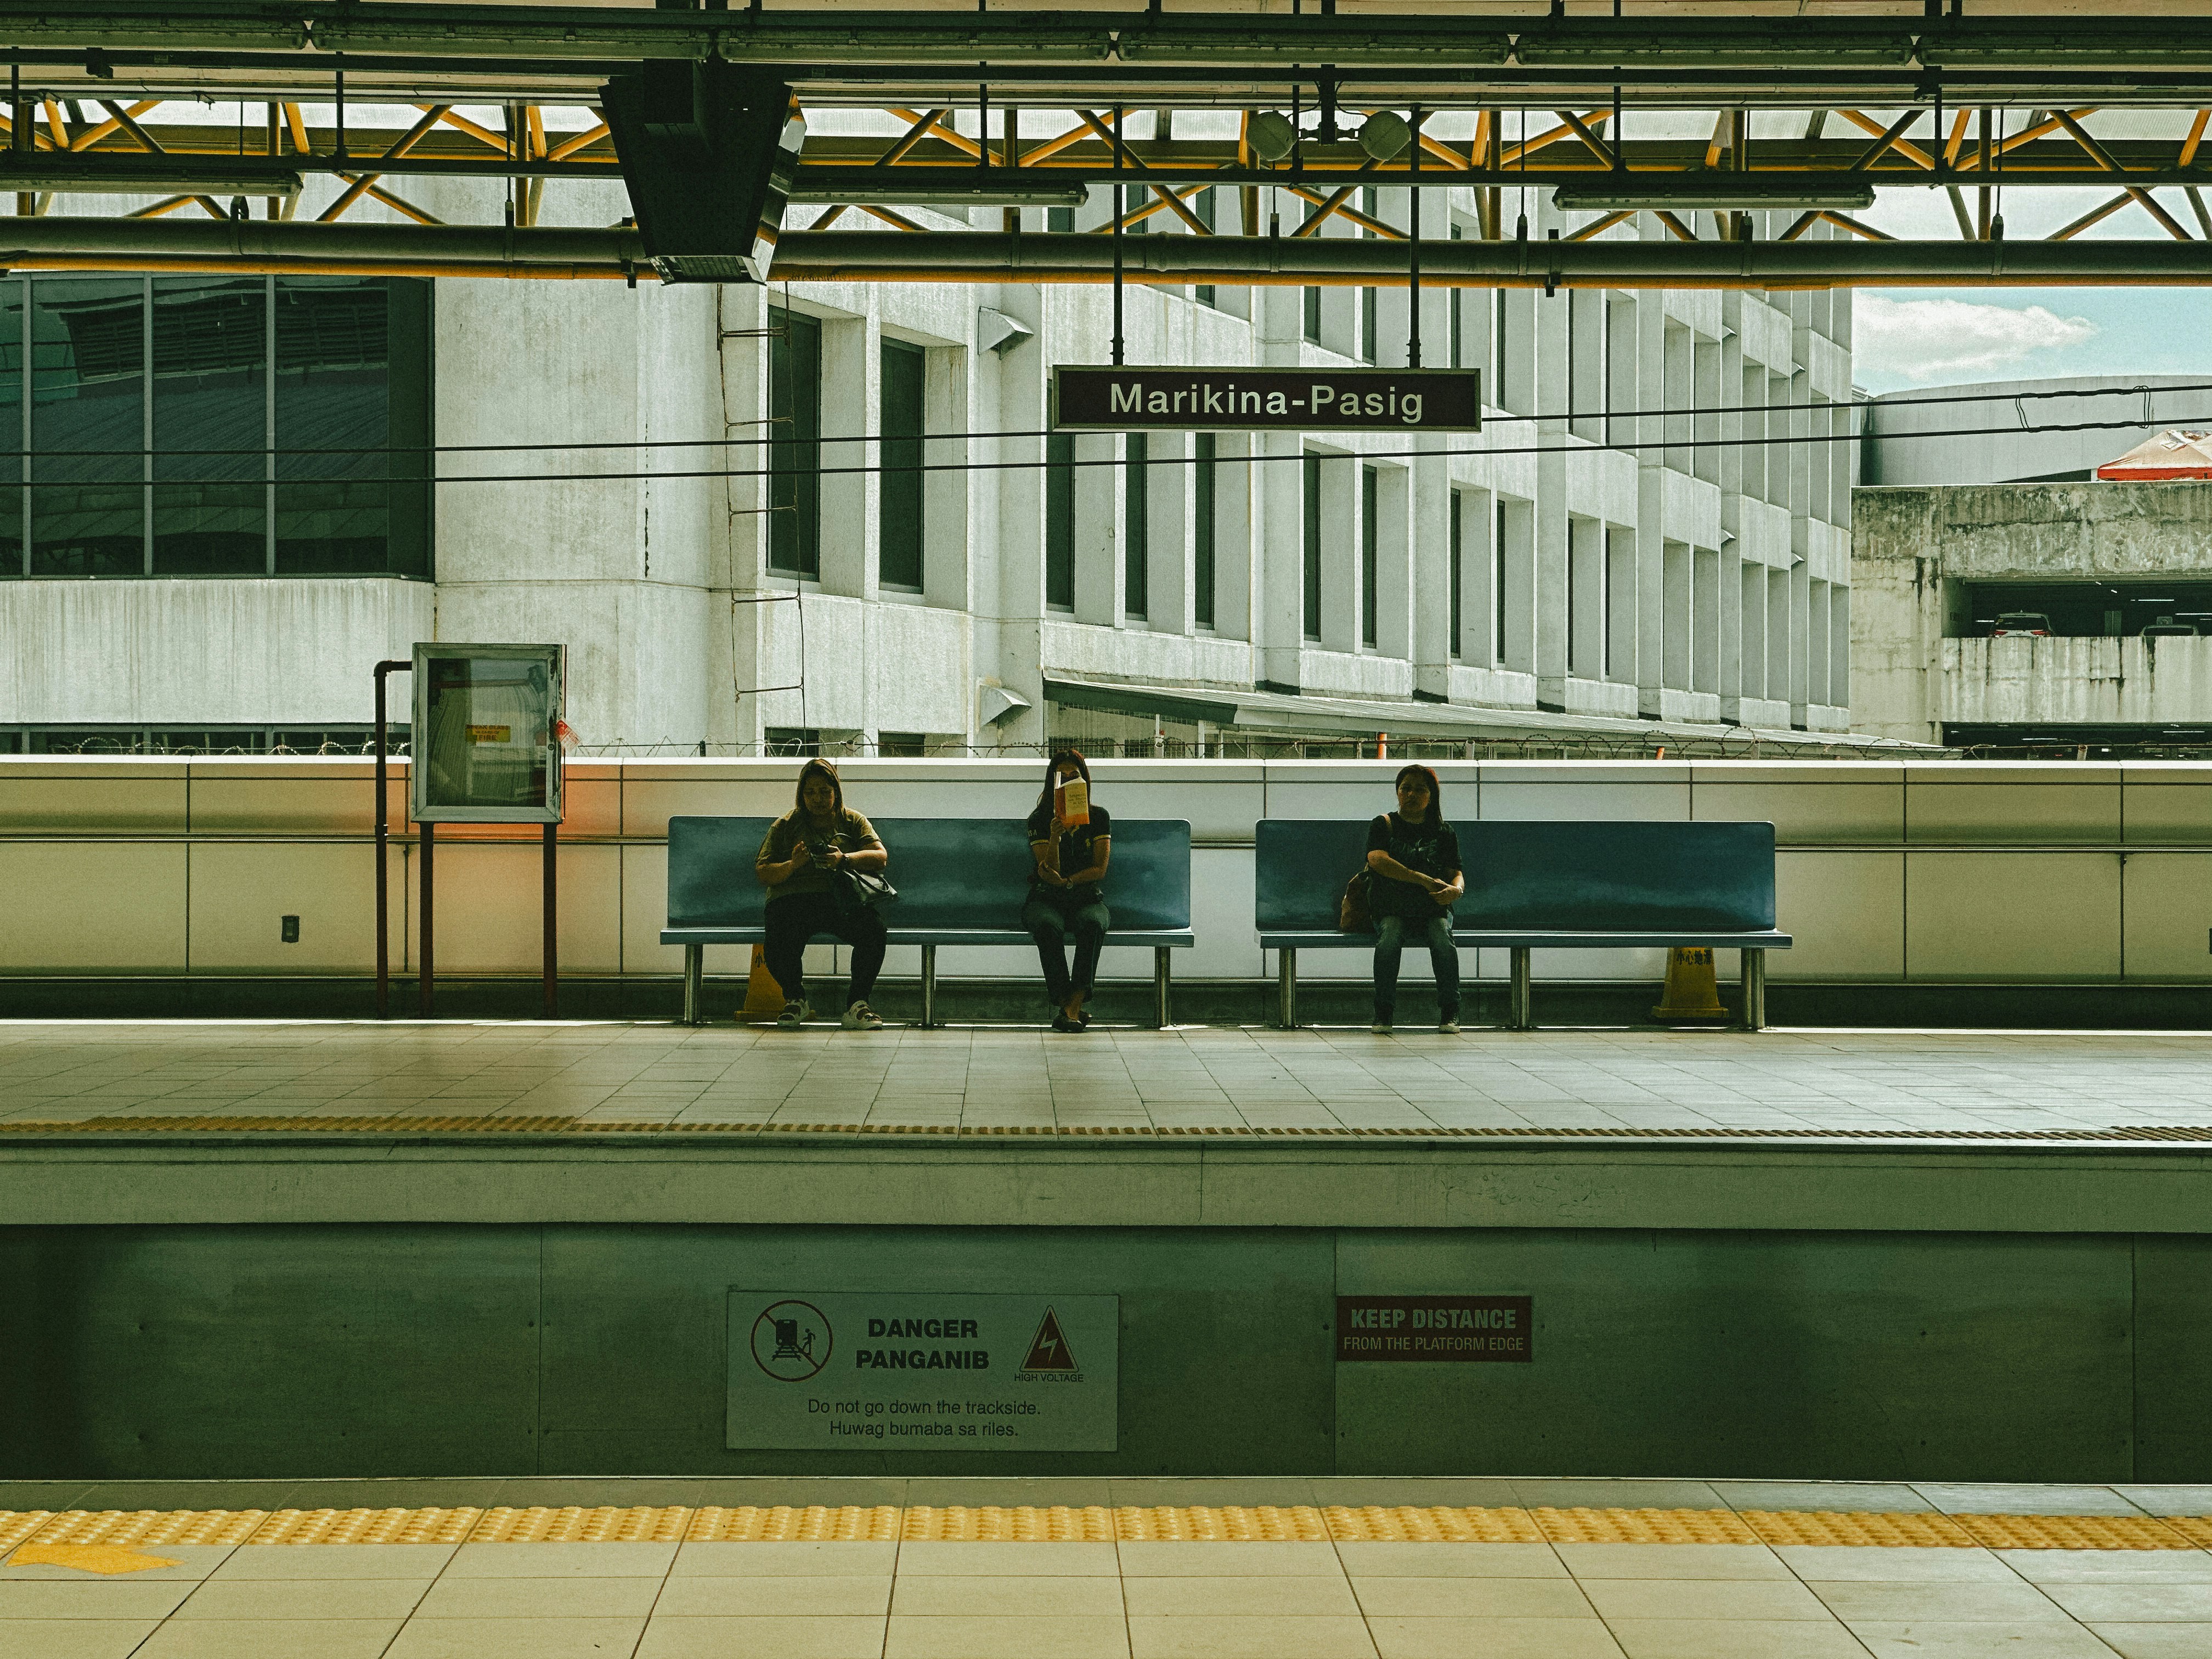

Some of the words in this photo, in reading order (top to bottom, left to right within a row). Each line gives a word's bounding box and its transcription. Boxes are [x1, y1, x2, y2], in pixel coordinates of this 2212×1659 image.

[1110, 383, 1423, 424] Marikina-Pasig
[1351, 1309, 1406, 1328] KEEP
[1413, 1309, 1516, 1329] DISTANCE
[868, 1319, 978, 1338] DANGER
[1344, 1337, 1381, 1350] FROM
[1385, 1337, 1410, 1350] THE
[1415, 1337, 1485, 1351] PLATFORM
[1489, 1337, 1523, 1351] EDGE
[856, 1350, 990, 1370] PANGANIB
[1014, 1373, 1037, 1381] HIGH
[1040, 1373, 1084, 1382] VOLTAGE
[808, 1399, 830, 1414] Do
[835, 1400, 859, 1413] not
[865, 1403, 884, 1417] go
[889, 1400, 931, 1414] down
[936, 1400, 961, 1414] the
[966, 1400, 1041, 1415] trackside.
[830, 1421, 884, 1438] Huwag
[889, 1421, 953, 1436] bumaba
[958, 1425, 977, 1436] sa
[982, 1421, 1019, 1436] riles.
